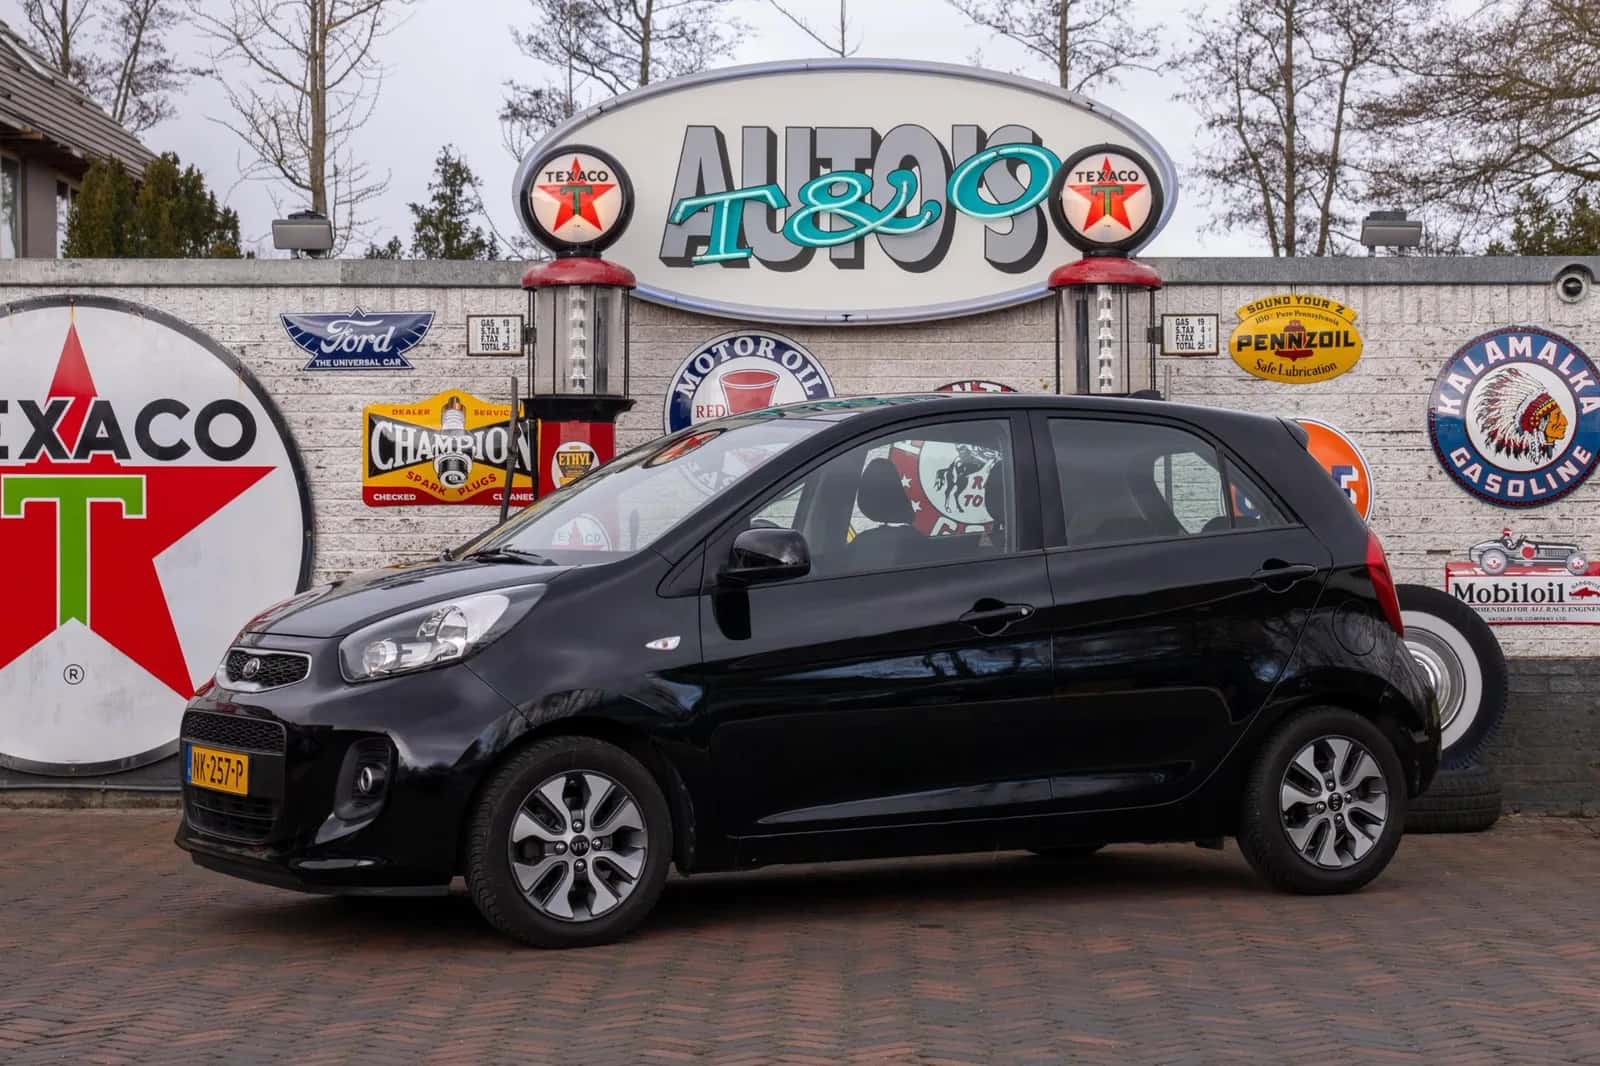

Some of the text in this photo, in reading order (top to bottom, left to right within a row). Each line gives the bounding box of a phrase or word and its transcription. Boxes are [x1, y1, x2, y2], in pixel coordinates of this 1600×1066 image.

[545, 171, 608, 182] TEXACO
[1075, 171, 1139, 182] TEXACO
[1247, 296, 1291, 314] SOUND
[1295, 295, 1330, 308] YOUR
[320, 318, 395, 354] Ford
[1237, 330, 1356, 352] PENNZOIL
[315, 359, 401, 367] THE UNIVERSAL CAR
[675, 336, 823, 399] MOTOR OIL
[1254, 358, 1337, 377] Safe Lubrication
[1438, 336, 1600, 416] KALAMALKA
[473, 408, 512, 417] SERVIC
[696, 404, 727, 418] RED
[0, 398, 257, 461] XACO
[559, 453, 592, 466] ETHYL
[1450, 446, 1592, 497] GASOLINE
[406, 471, 497, 497] SPARK PLUGS
[1453, 582, 1565, 603] Mobiloil
[193, 751, 244, 789] NK-257-P
